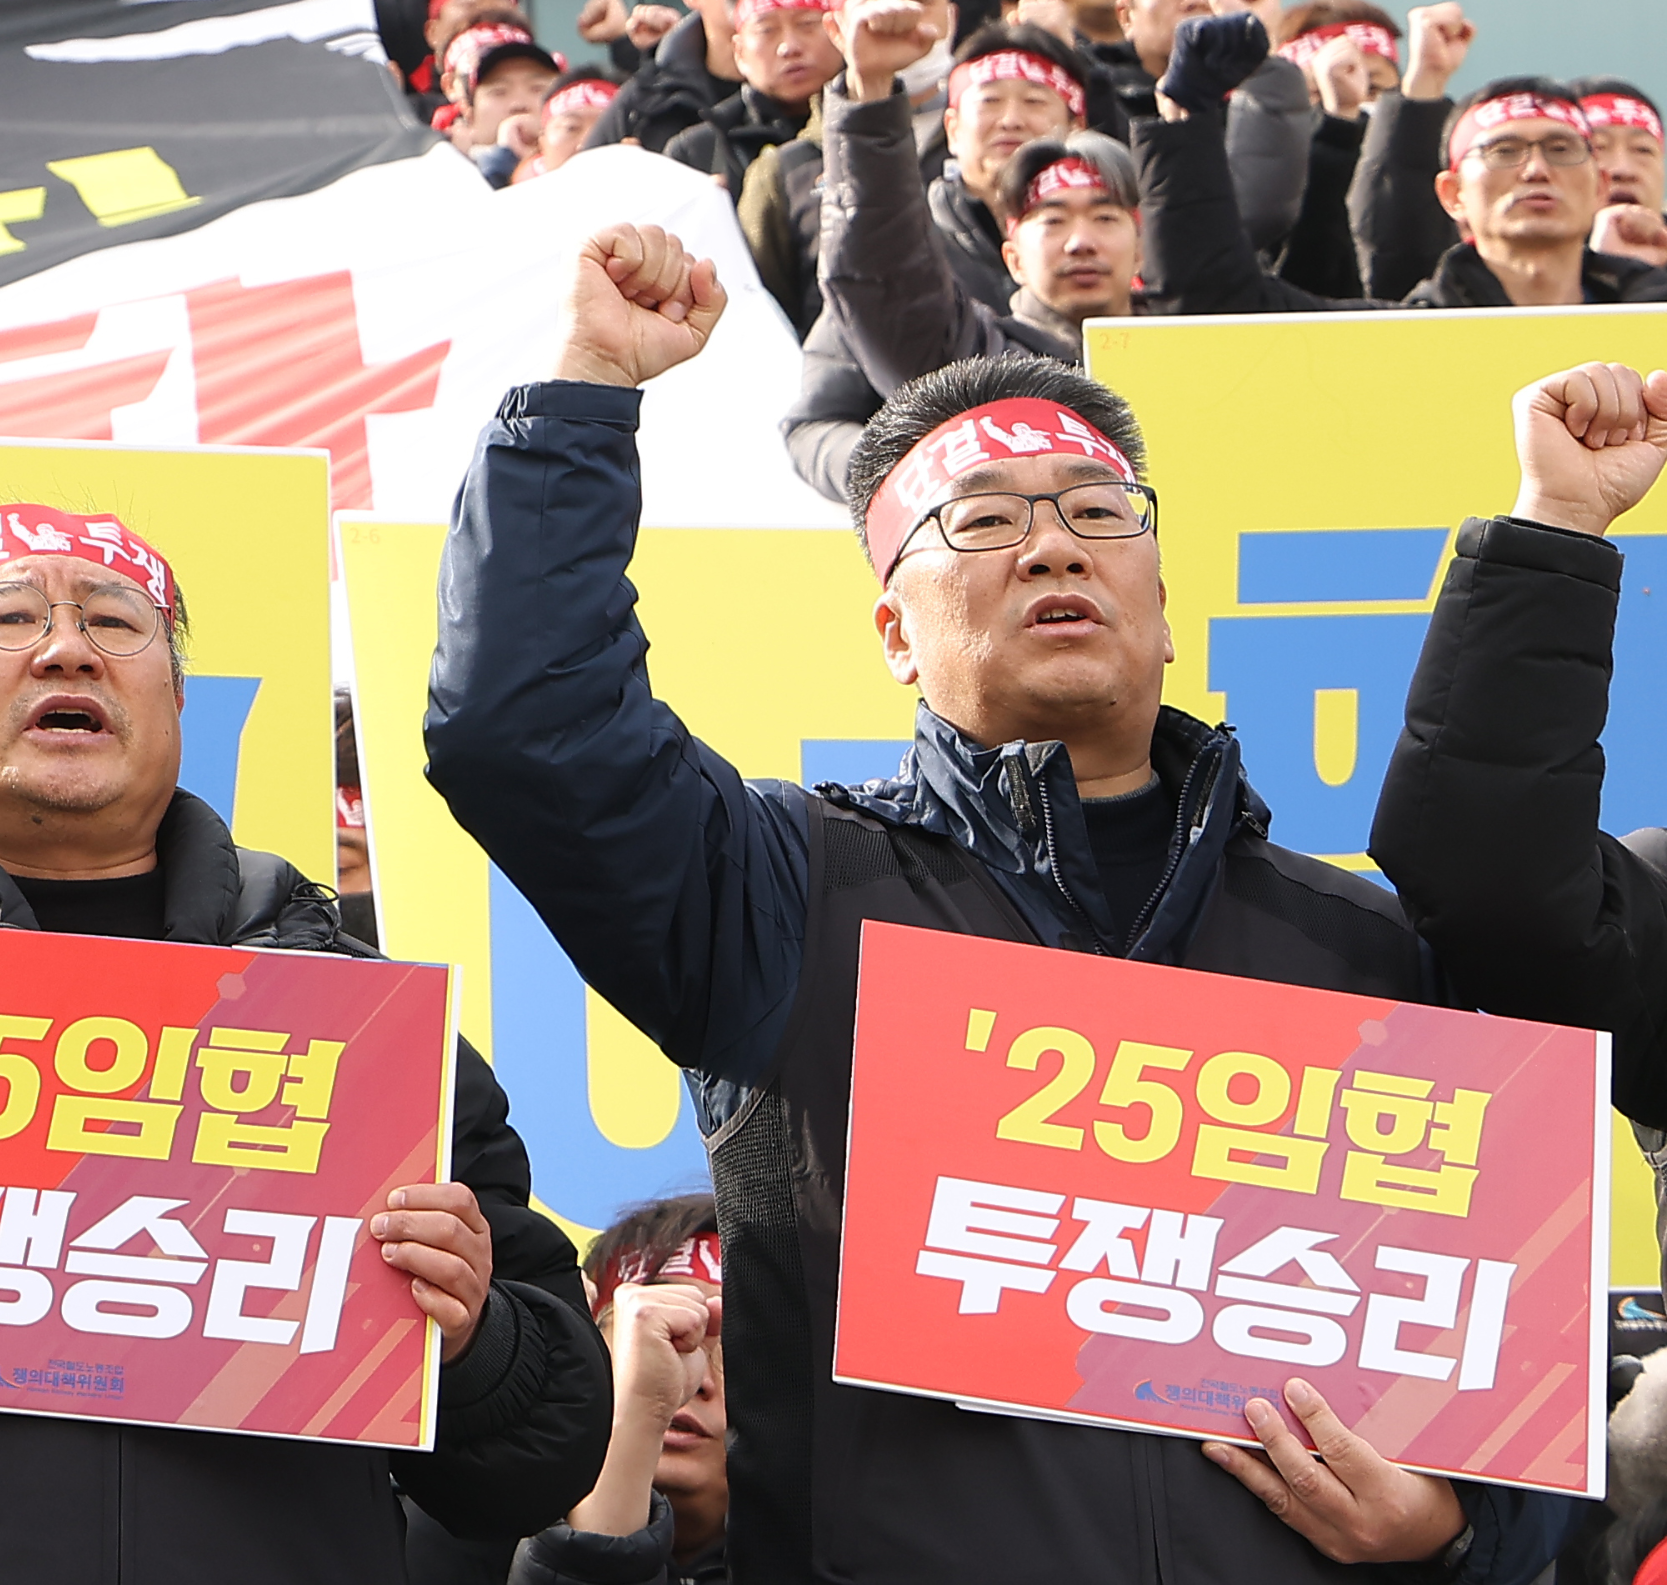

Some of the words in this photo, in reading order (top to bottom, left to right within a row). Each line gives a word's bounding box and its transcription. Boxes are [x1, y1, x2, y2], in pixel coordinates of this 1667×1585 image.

[893, 417, 989, 516] 단결
[78, 520, 168, 608] 투쟁
[964, 1007, 1493, 1217] '25임협
[915, 1174, 1518, 1393] 투쟁승리
[12, 1367, 124, 1393] 쟁의대책위원회
[1165, 1384, 1280, 1411] 쟁의대책위
